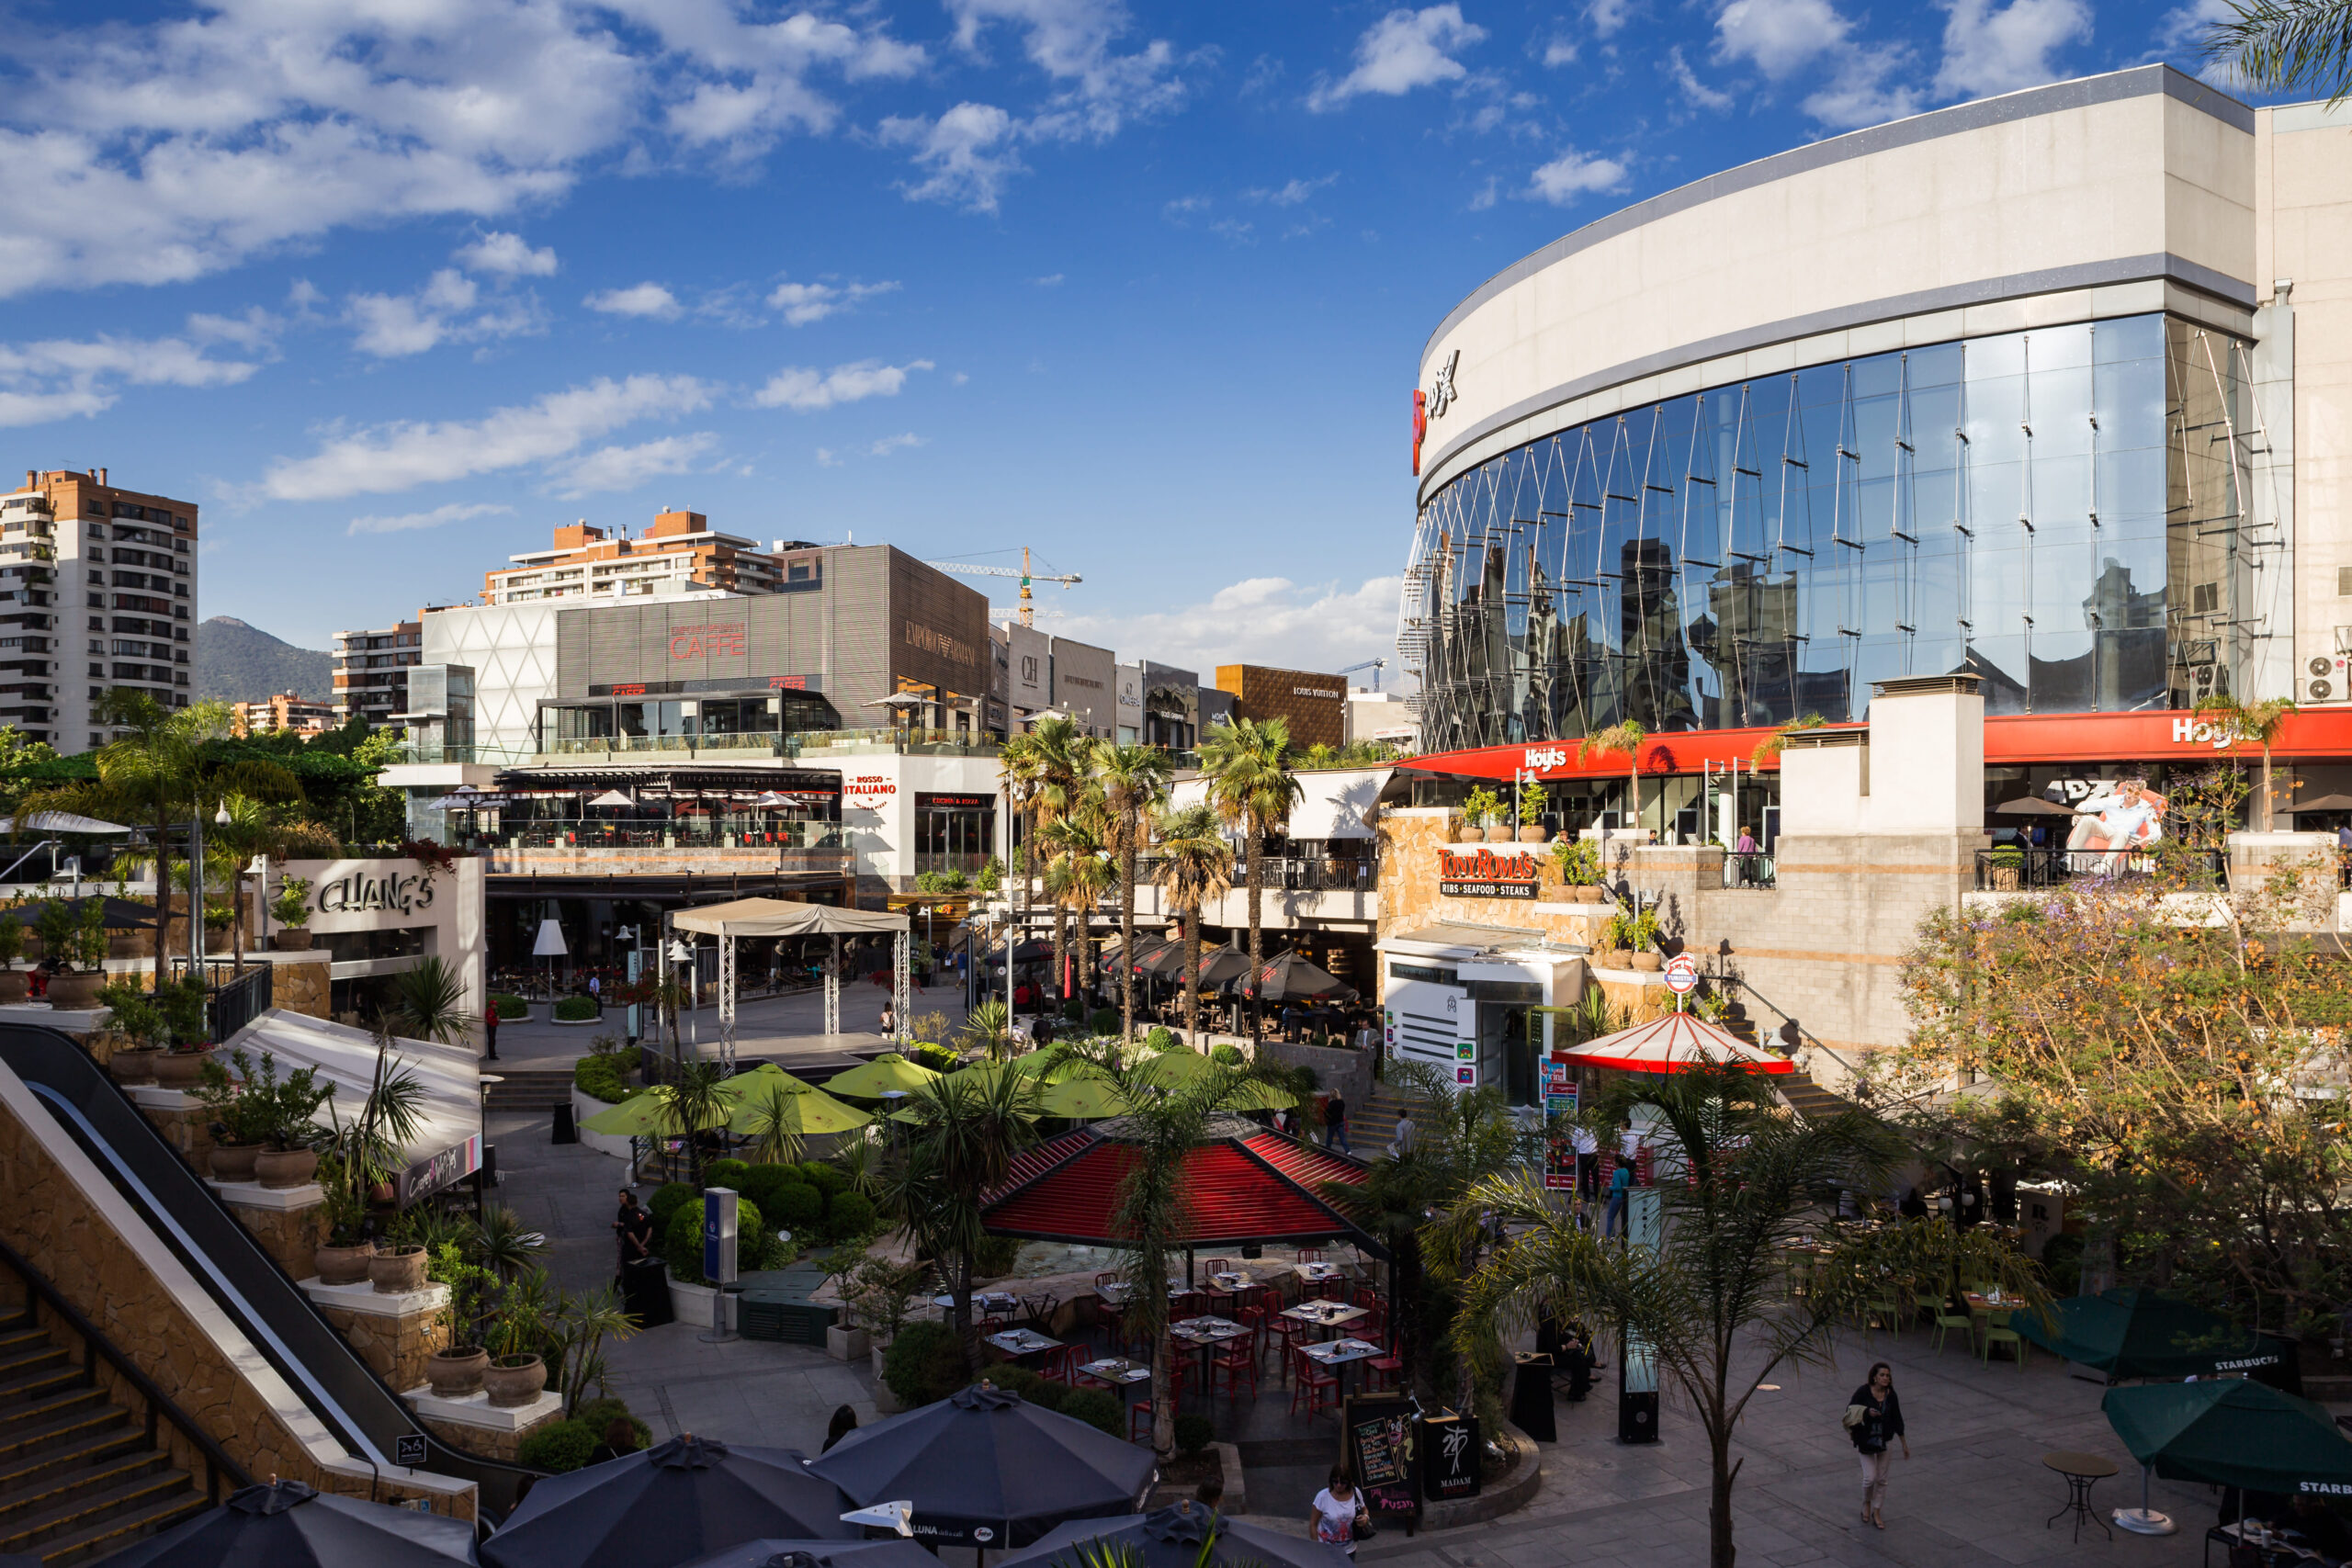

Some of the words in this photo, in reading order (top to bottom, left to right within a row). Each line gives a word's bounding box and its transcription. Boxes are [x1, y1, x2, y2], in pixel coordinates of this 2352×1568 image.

[670, 633, 745, 660] CAFFE
[1022, 655, 1038, 682] CH
[1294, 687, 1312, 696] LOUIS
[1313, 689, 1339, 699] VUITTON
[1526, 748, 1566, 772] Hoyts
[844, 784, 897, 795] ITALIANO
[1438, 850, 1477, 876] TONY
[1477, 849, 1535, 883] ROMA'S
[320, 873, 434, 915] CHANG'S
[1442, 884, 1459, 894] RIBS
[1463, 884, 1496, 895] SEAFOOD
[1500, 886, 1530, 897] STEAKS
[2215, 1355, 2278, 1371] STARBUCKS
[1441, 1477, 1471, 1488] MADAM
[2300, 1481, 2352, 1495] STARB
[913, 1525, 938, 1535] LUNA
